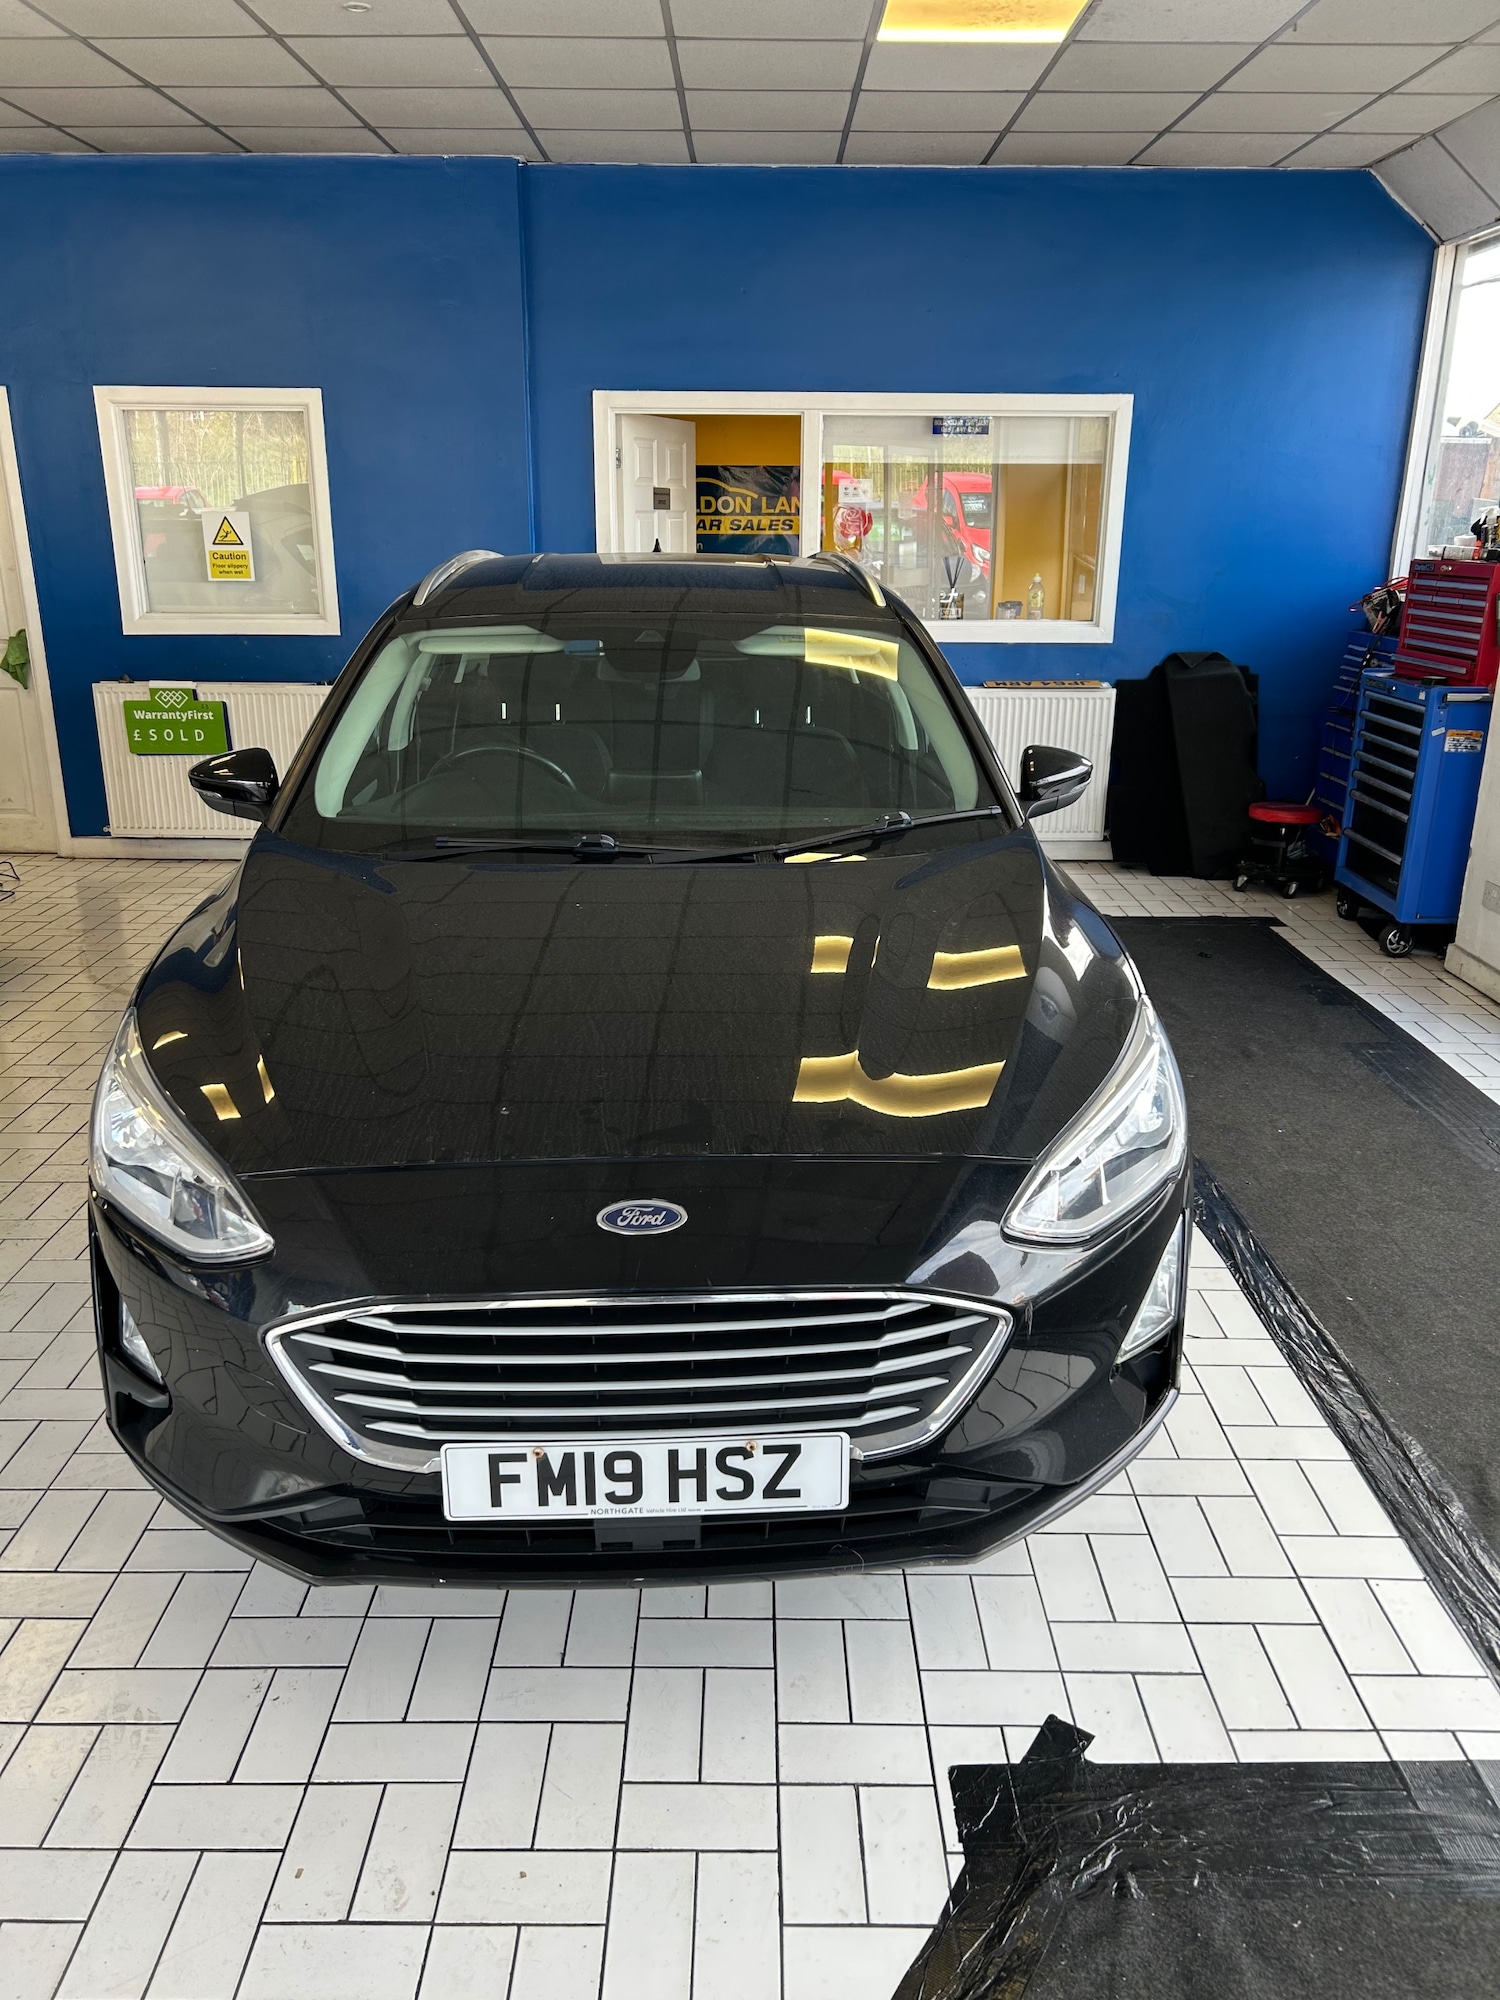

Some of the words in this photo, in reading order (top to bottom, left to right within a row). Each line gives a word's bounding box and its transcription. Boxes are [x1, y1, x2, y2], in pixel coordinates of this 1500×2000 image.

[696, 495, 752, 514] DON
[729, 519, 794, 531] SALES
[212, 552, 247, 560] Caution
[133, 710, 214, 722] WarrantyFirst
[133, 729, 142, 741] £
[149, 729, 204, 741] SOLD
[617, 1207, 667, 1226] Ford
[487, 1450, 643, 1508] FM19
[668, 1444, 802, 1503] HSZ
[590, 1507, 644, 1515] NORTHGATE
